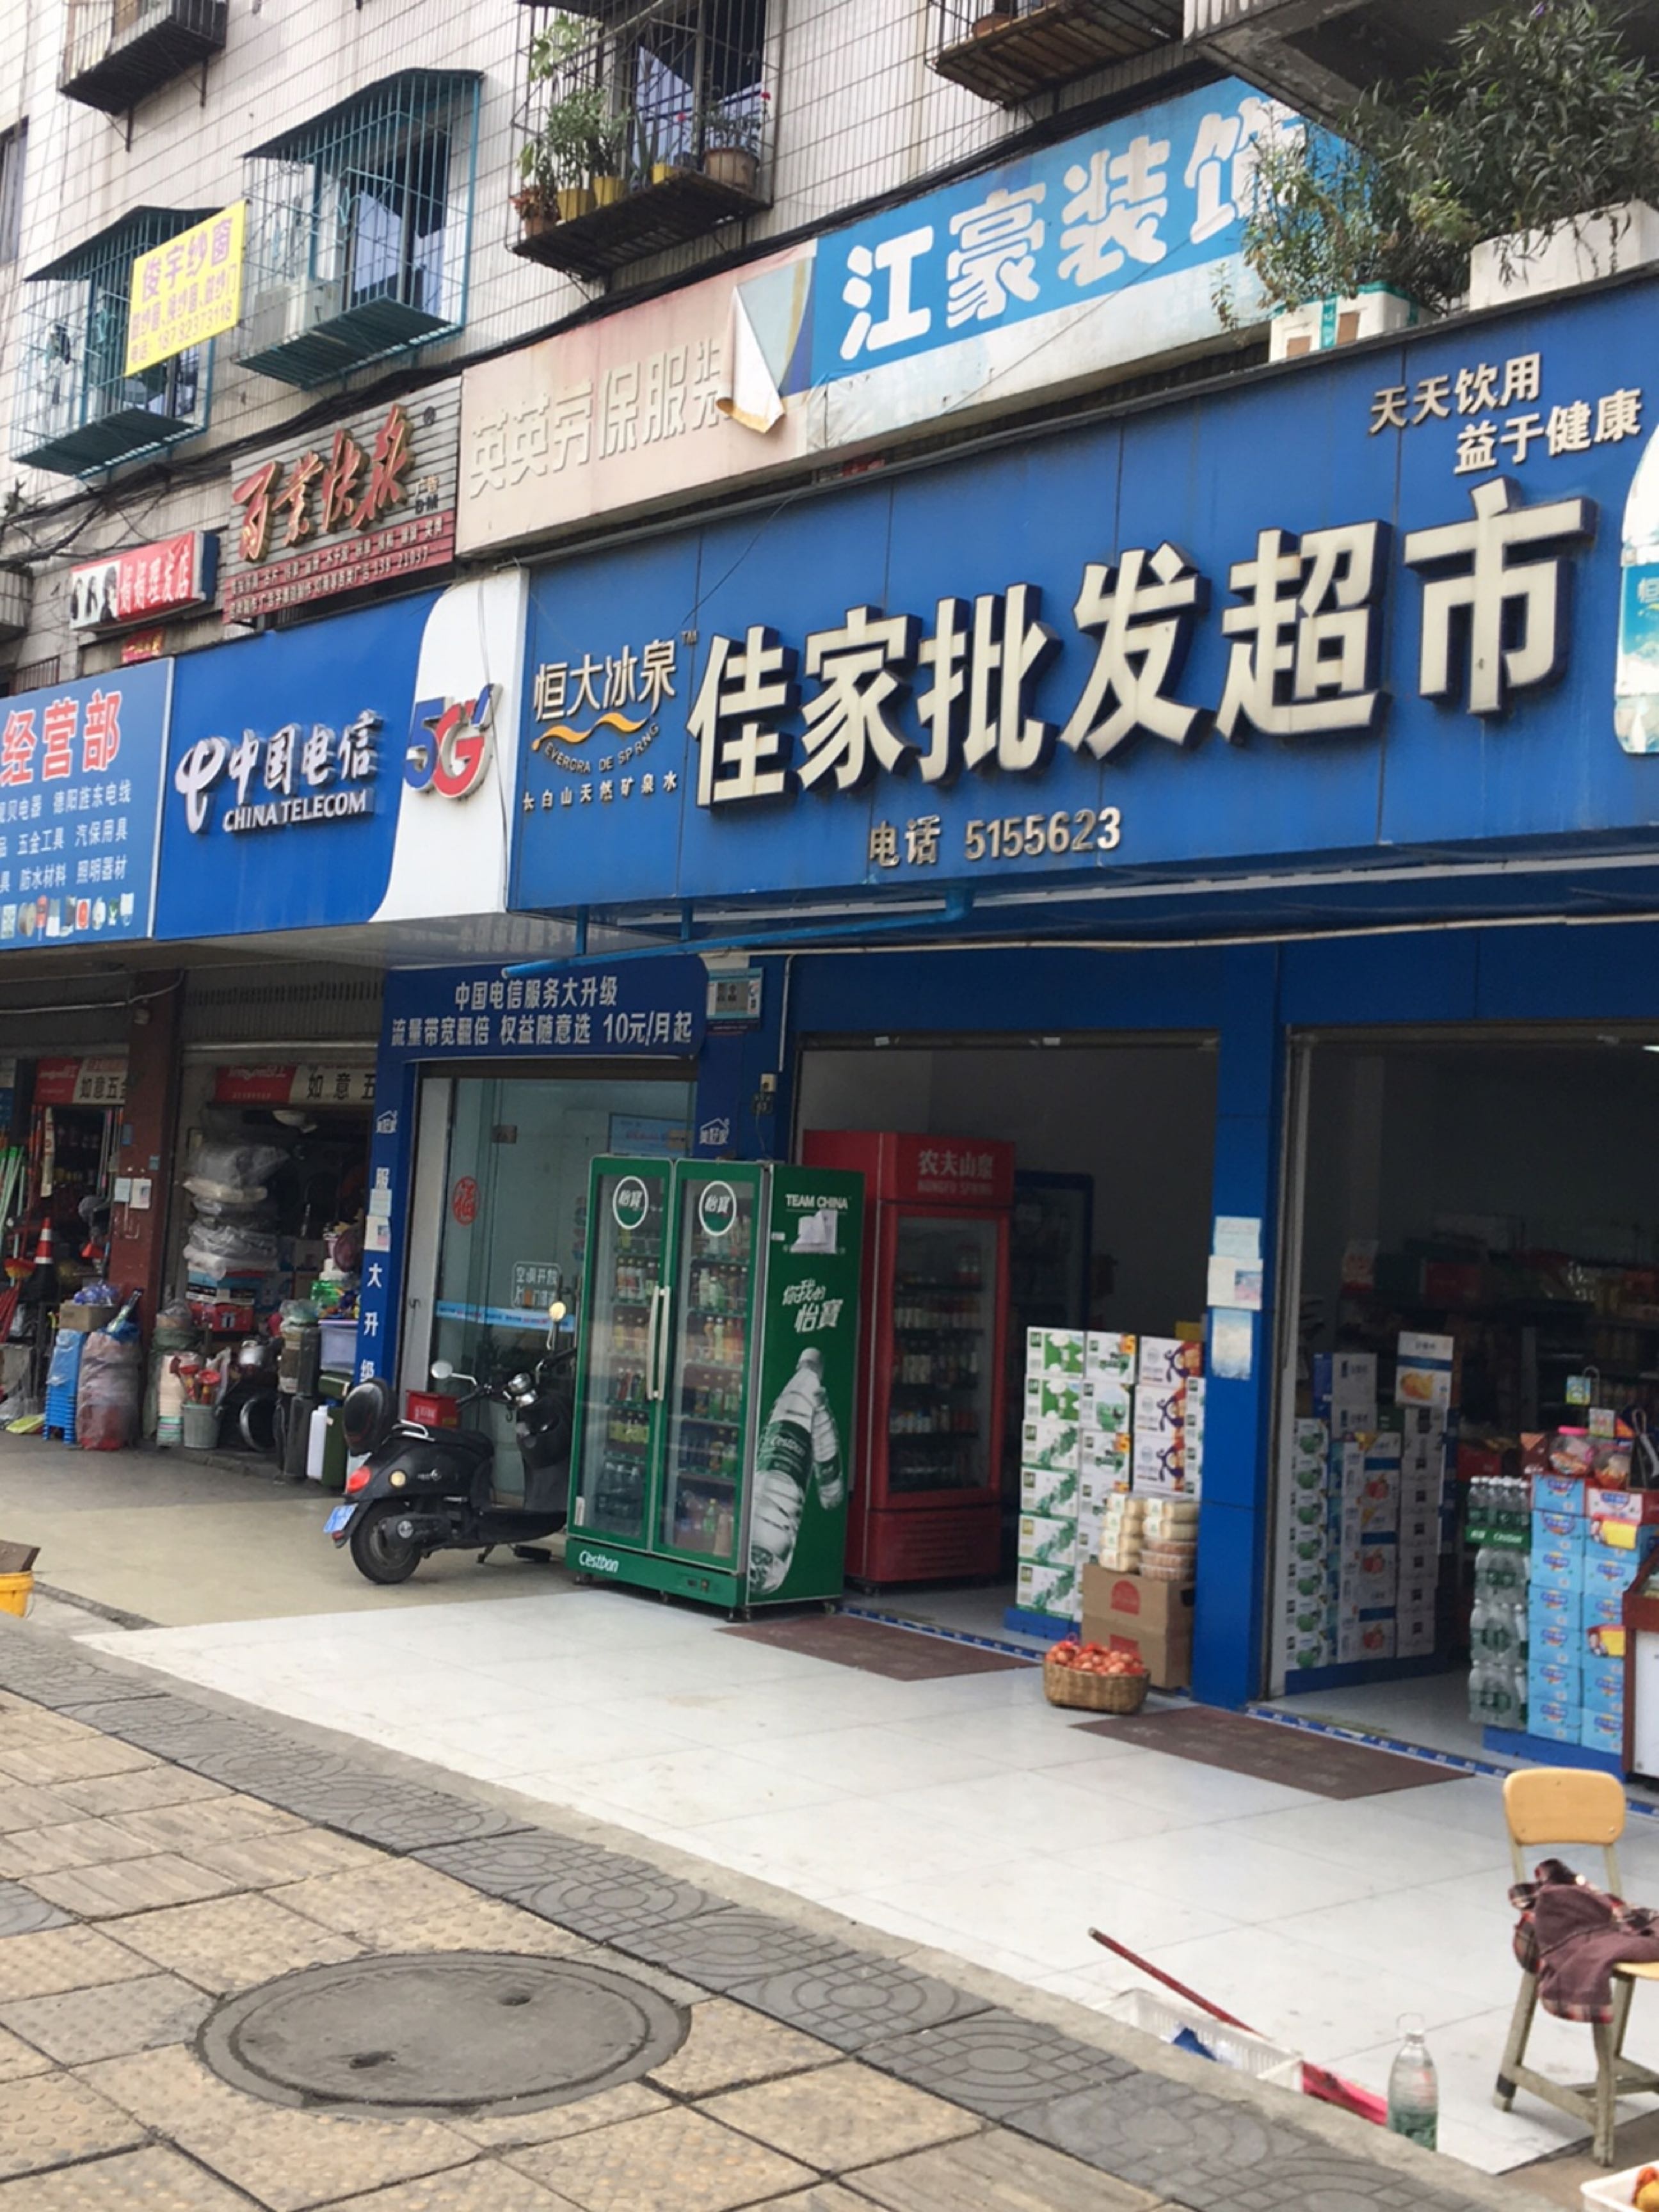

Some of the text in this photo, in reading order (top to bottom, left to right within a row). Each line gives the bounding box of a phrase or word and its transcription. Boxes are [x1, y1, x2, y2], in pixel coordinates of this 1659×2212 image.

[1369, 353, 1542, 435] 天天饮用
[1454, 389, 1642, 474] 益于健康
[687, 476, 1589, 808] 佳家批发超市
[533, 639, 677, 723] 恒大冰泉
[0, 689, 122, 788] 经营部
[228, 709, 379, 805] 中国电信
[222, 789, 367, 833] CHINA TELECOM
[523, 770, 678, 812] 长白山天然矿泉水
[17, 827, 65, 855] 五金工具
[869, 806, 1122, 867] 电话 5155623
[19, 863, 66, 892] 防水材料
[76, 854, 128, 885] 照明器材
[454, 976, 618, 1011] 中国电信服务大升级
[390, 1010, 693, 1048] 流量带宽翻倍 权益随意选 10元/月起
[917, 1148, 994, 1181] 农夫山泉
[785, 1193, 848, 1209] TEAM CHINA
[579, 1549, 620, 1573] Cestbon
